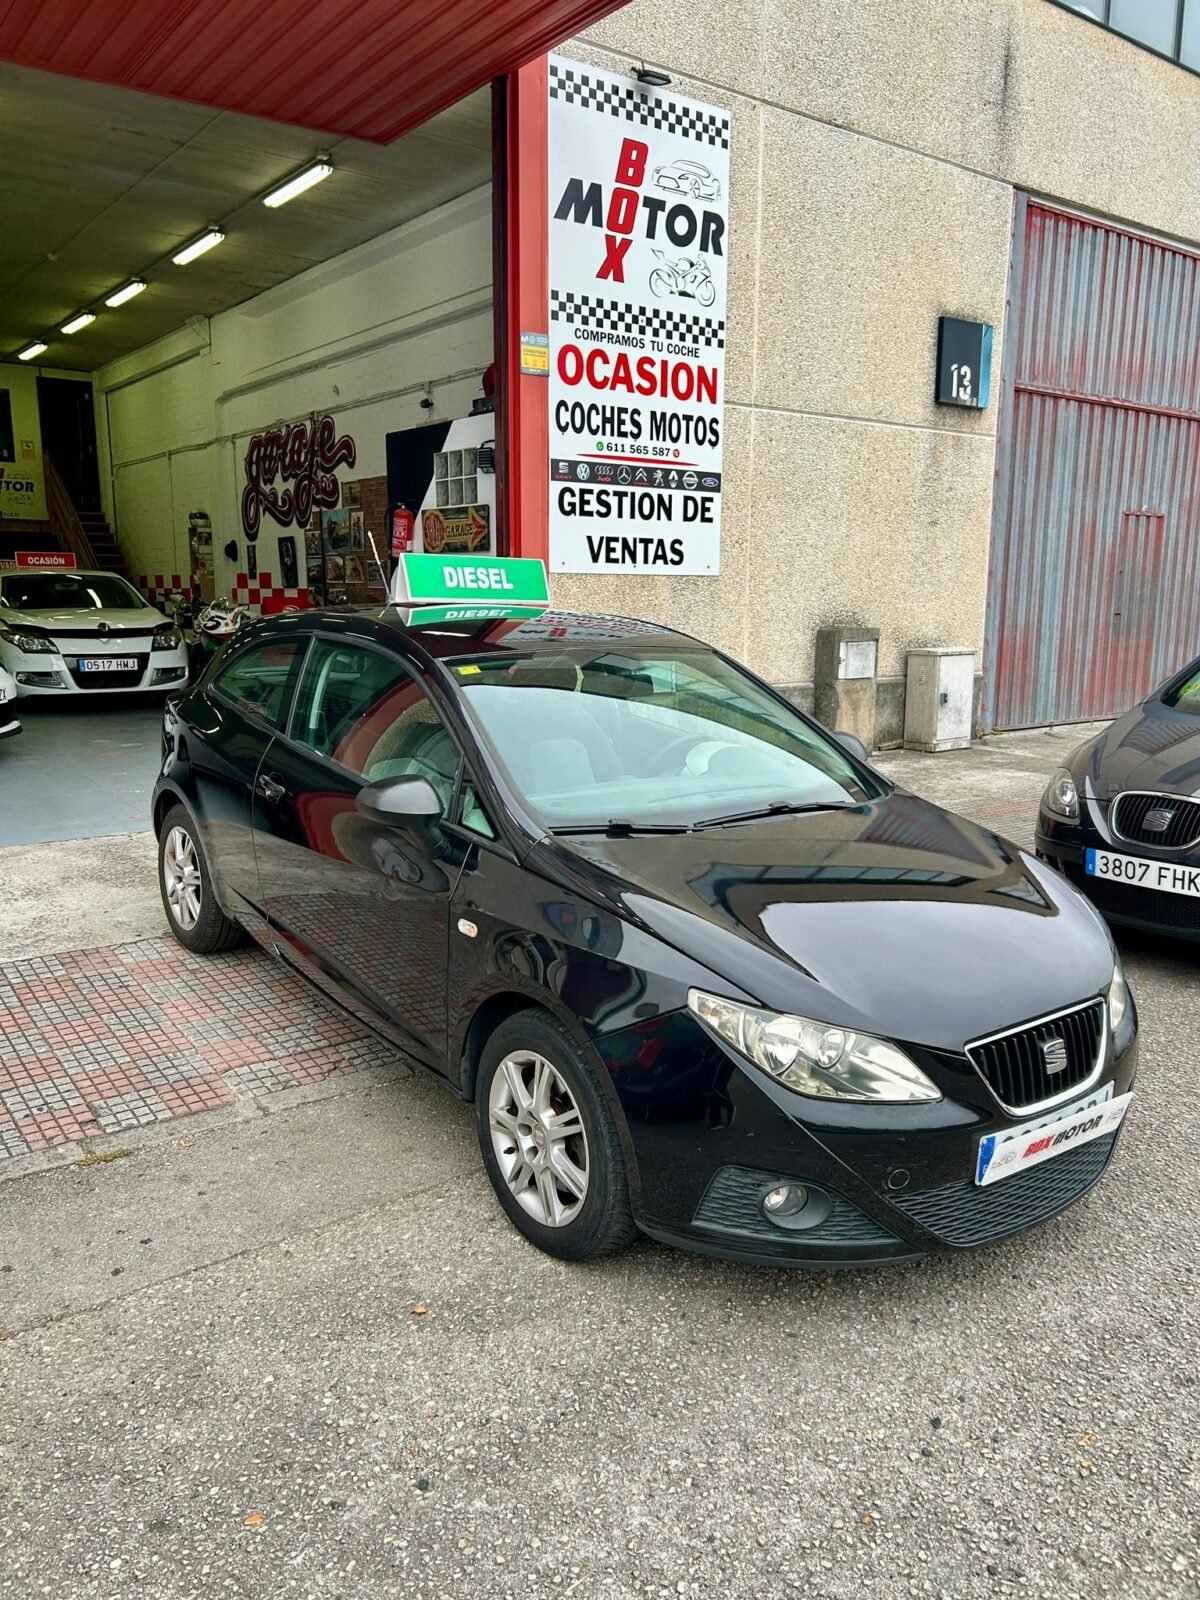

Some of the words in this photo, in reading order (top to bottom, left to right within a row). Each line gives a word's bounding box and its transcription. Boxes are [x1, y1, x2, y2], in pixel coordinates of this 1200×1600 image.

[596, 137, 649, 283] BOX
[574, 328, 646, 350] COMPRAMOS
[650, 340, 664, 352] TU
[667, 343, 700, 358] COCHE
[557, 344, 718, 405] OCASION
[950, 363, 971, 400] 13
[555, 399, 641, 441] COCHES
[649, 410, 720, 448] MOTOS
[606, 442, 625, 453] 611
[629, 444, 649, 455] 565
[652, 447, 670, 457] 587
[2, 480, 35, 492] TOR
[558, 486, 673, 521] GESTION
[683, 496, 714, 523] DE
[445, 523, 473, 538] GARAGE
[27, 555, 65, 565] OCASIÓN
[586, 536, 684, 566] VENTAS
[442, 566, 514, 589] DIESEL
[86, 660, 112, 670] 0517
[116, 659, 135, 669] HMJ
[1099, 855, 1150, 882] 3807
[1158, 865, 1200, 893] FHK
[1022, 1134, 1055, 1158] BOX
[1052, 1114, 1103, 1146] MOTOR
